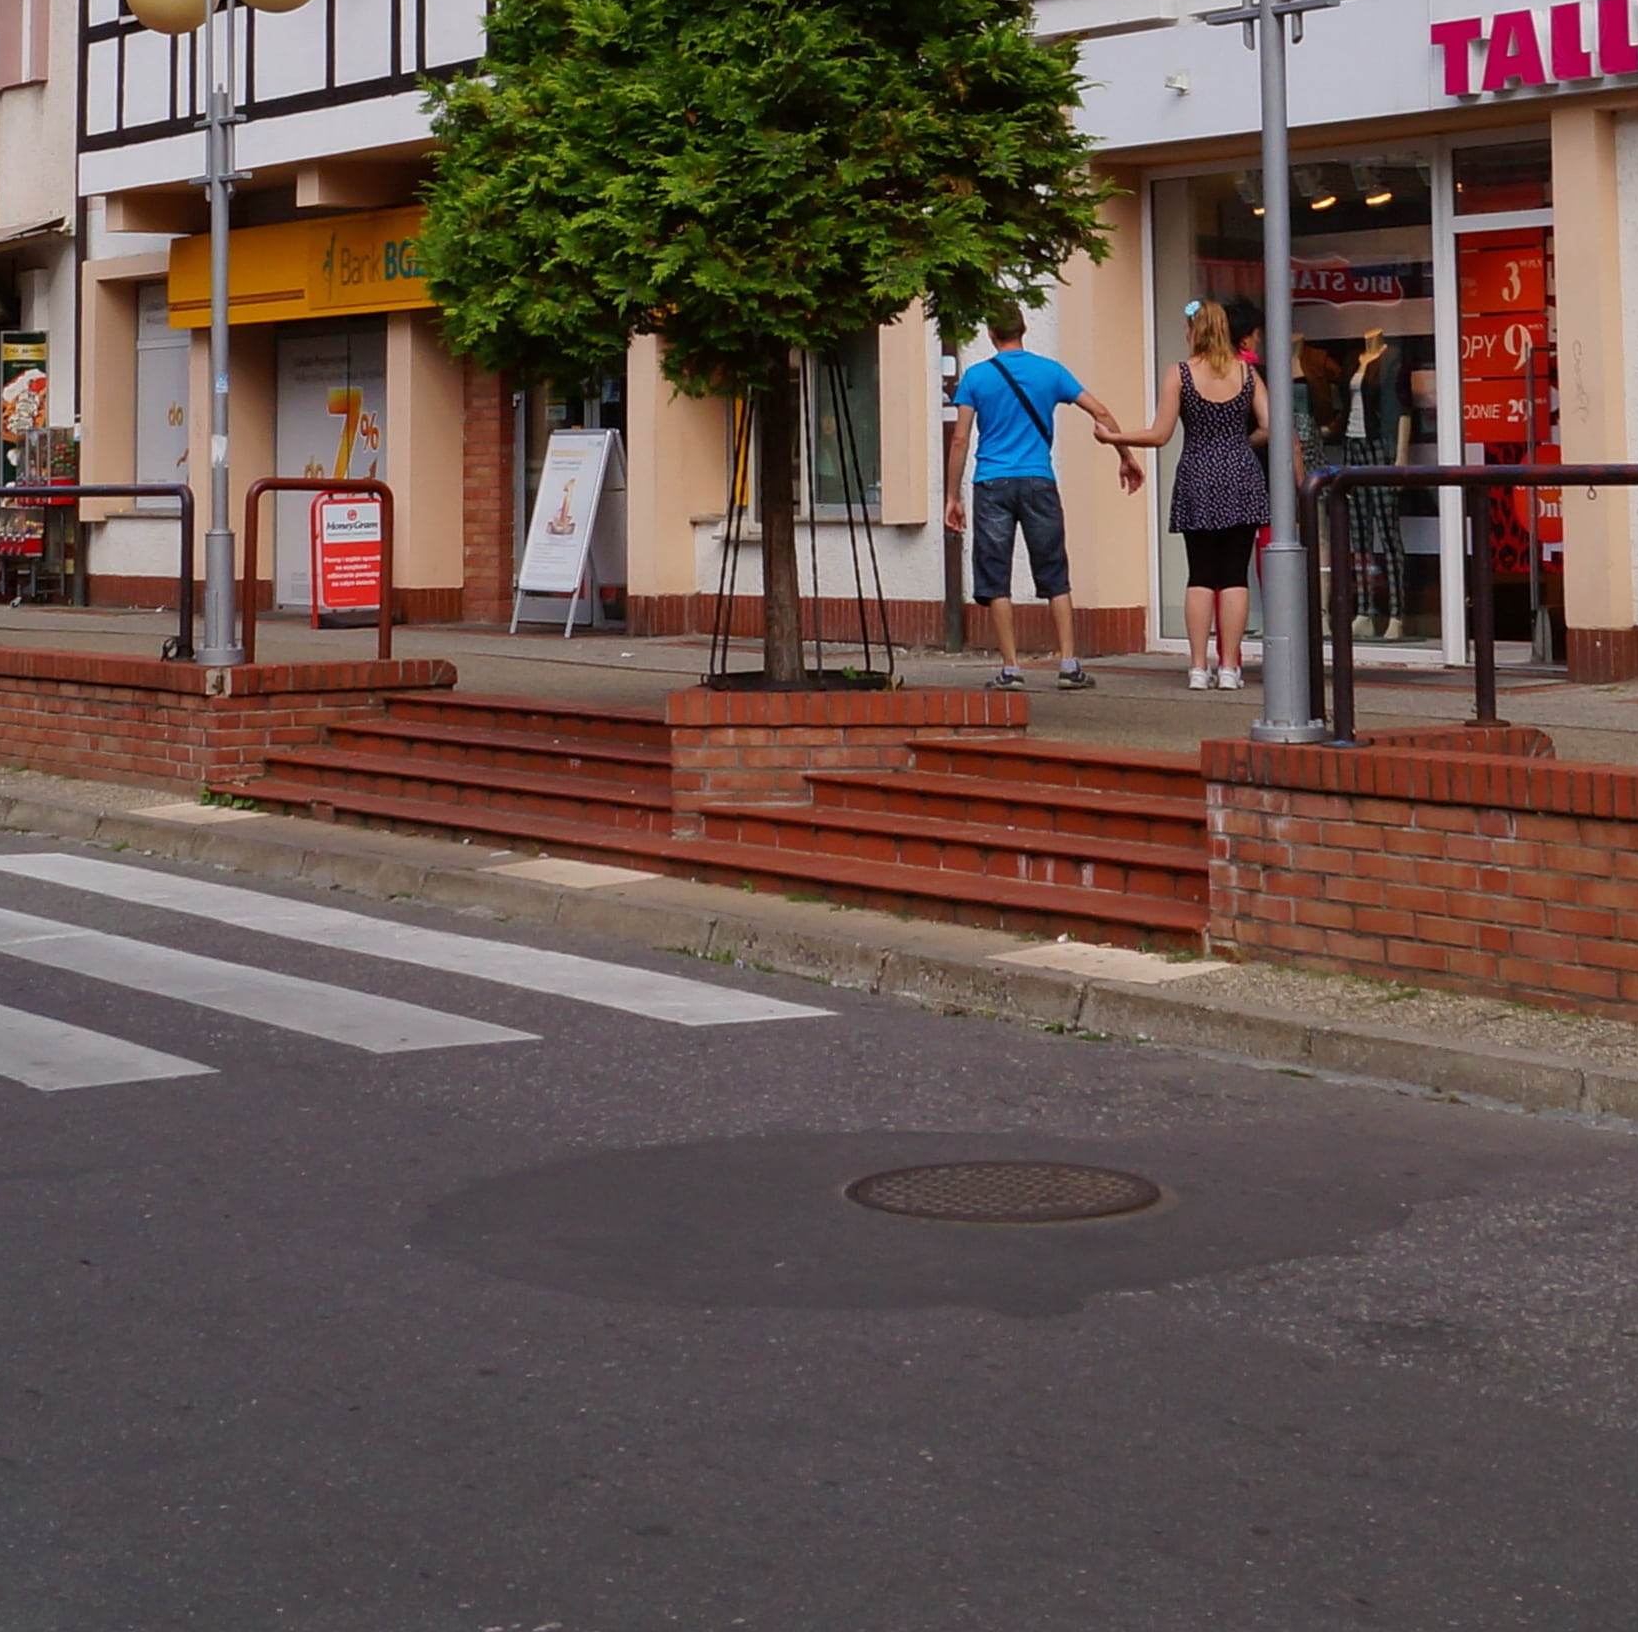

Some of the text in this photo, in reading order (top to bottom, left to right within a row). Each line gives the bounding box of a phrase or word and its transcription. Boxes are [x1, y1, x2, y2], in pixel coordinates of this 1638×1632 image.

[340, 241, 381, 286] Bank
[1501, 260, 1521, 302] 3
[1503, 323, 1533, 371] 9
